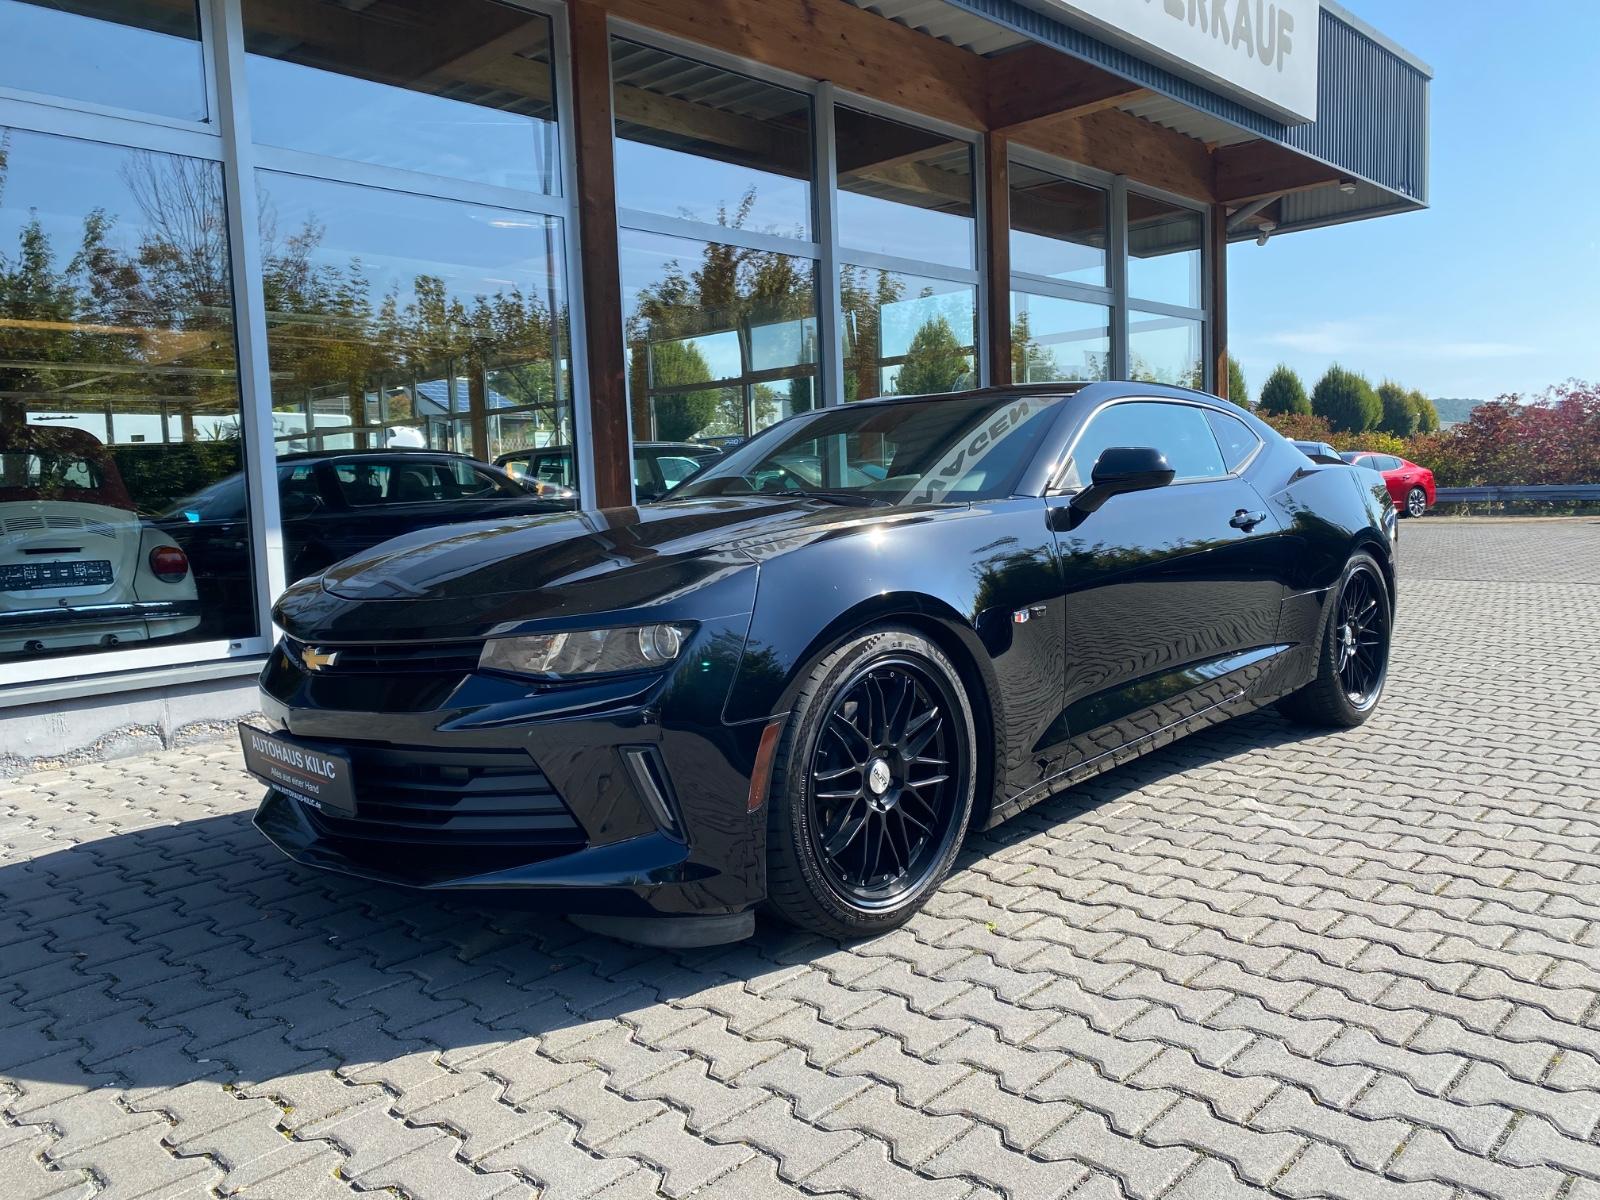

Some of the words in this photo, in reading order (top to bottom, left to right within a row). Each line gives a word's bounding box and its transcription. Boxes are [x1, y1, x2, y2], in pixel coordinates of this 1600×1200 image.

[251, 735, 304, 769] AUTOHAUS
[304, 754, 336, 779] KILIC
[304, 780, 320, 794] Hand
